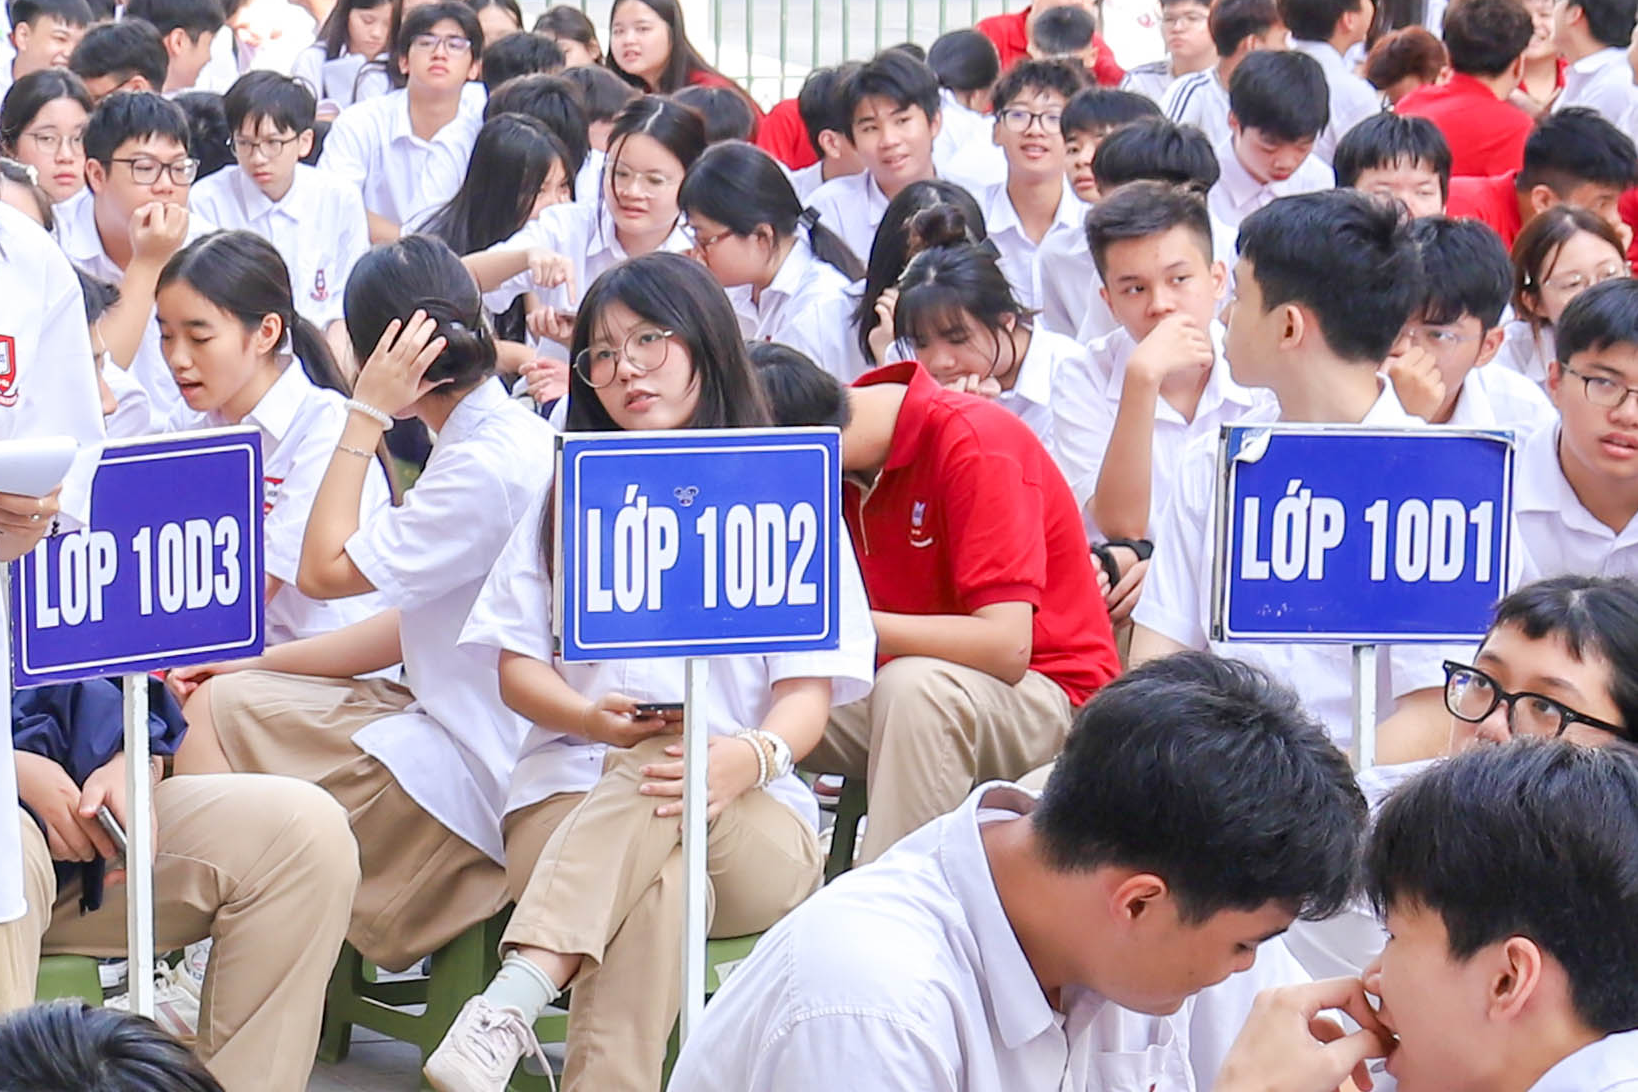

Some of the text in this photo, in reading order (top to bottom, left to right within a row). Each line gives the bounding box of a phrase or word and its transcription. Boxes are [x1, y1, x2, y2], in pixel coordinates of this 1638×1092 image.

[131, 515, 241, 616] 10D3
[586, 483, 818, 613] LỚP 10D2
[1240, 479, 1494, 582] LỚP 10D1
